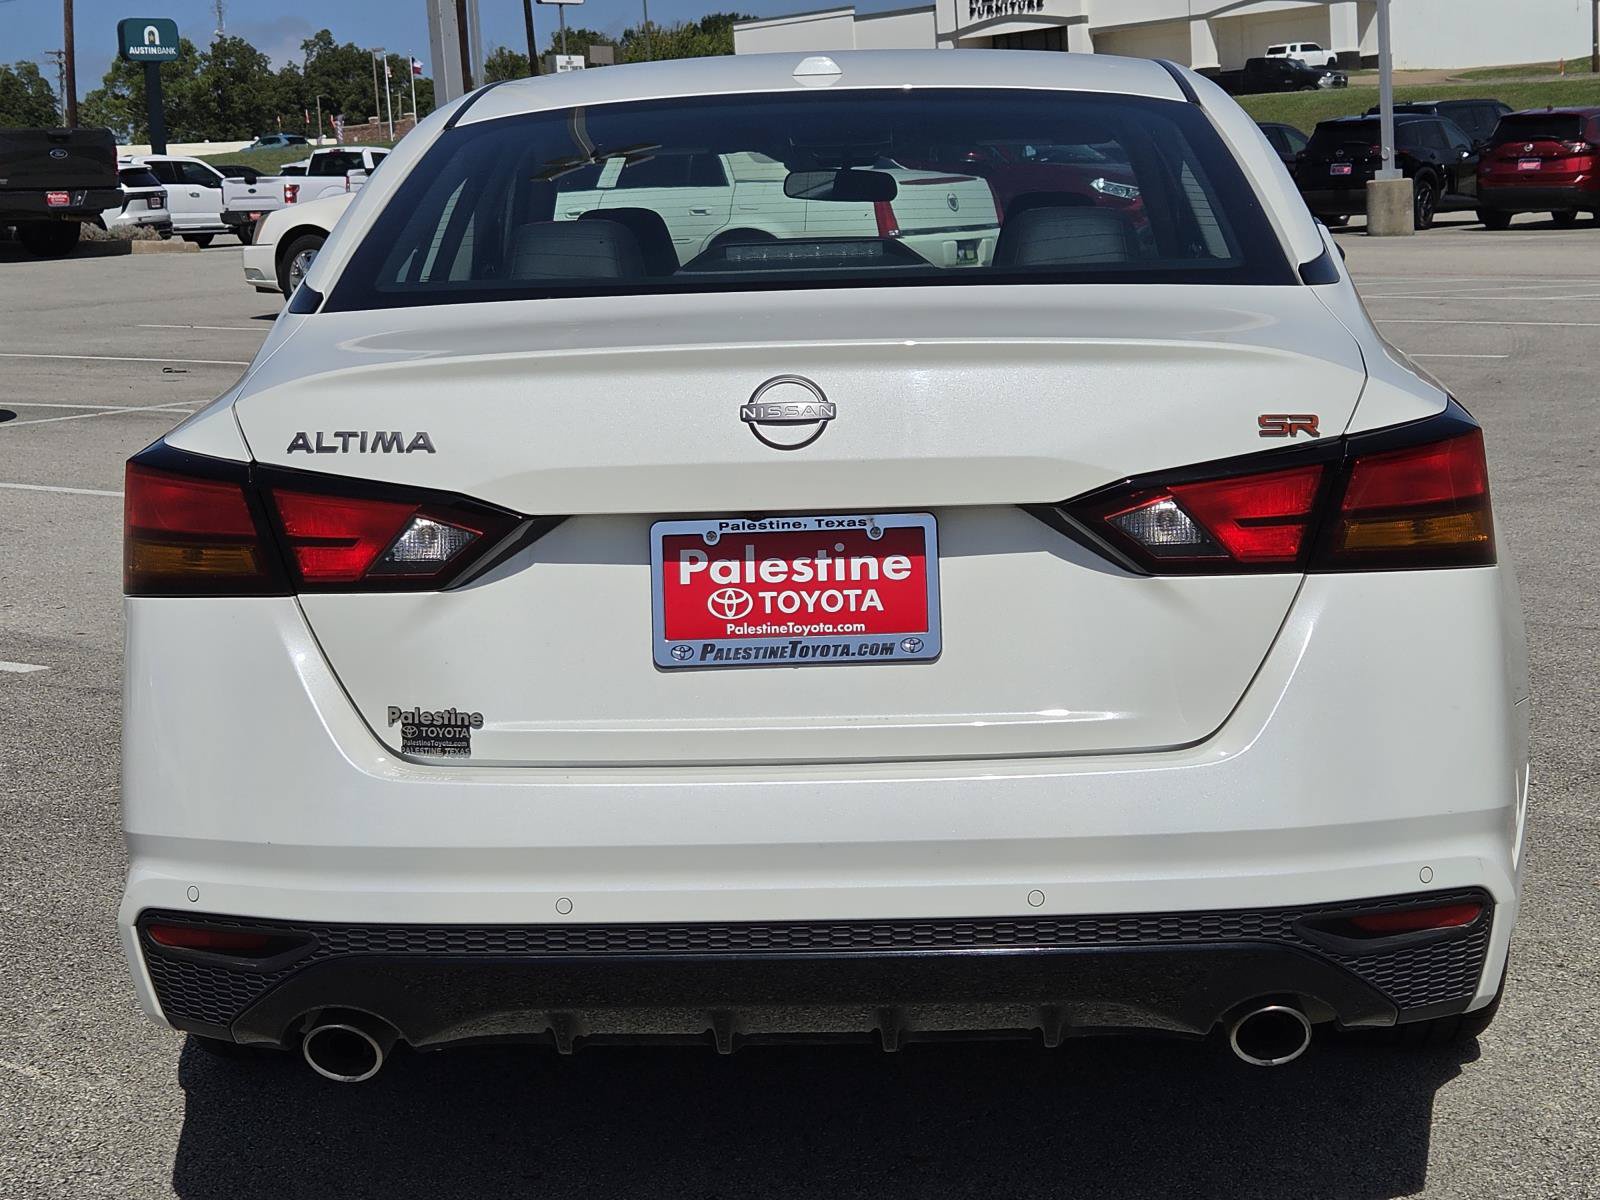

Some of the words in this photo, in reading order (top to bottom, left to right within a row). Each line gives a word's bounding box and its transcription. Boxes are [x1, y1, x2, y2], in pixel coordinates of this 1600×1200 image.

[741, 404, 835, 419] NISSAN
[1258, 414, 1321, 438] SR
[286, 431, 437, 454] ALTIMA
[718, 520, 808, 533] Palestine,
[815, 518, 867, 529] Texas
[679, 542, 912, 585] Palestine
[758, 589, 884, 614] TOYOTA
[726, 622, 866, 636] PalestineToyota.com
[387, 706, 484, 729] Palestine
[420, 727, 470, 738] TOYOTA
[445, 747, 470, 757] TEXAS
